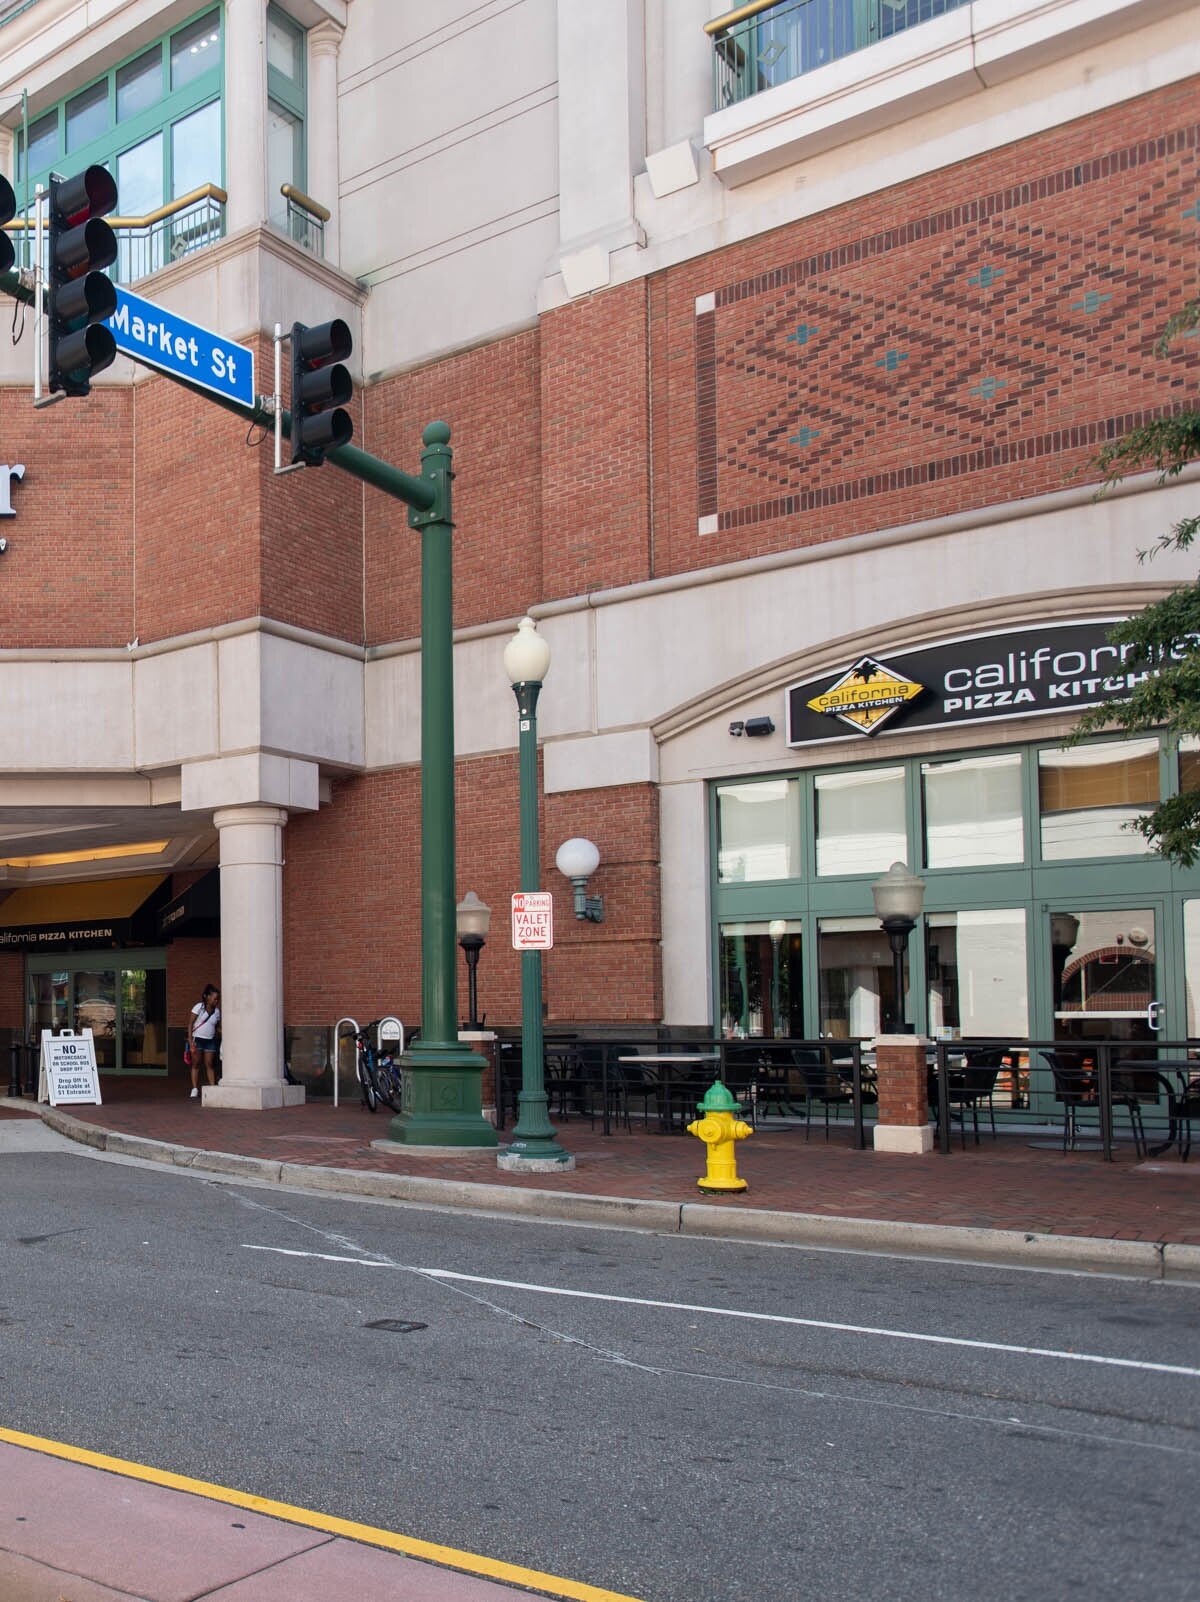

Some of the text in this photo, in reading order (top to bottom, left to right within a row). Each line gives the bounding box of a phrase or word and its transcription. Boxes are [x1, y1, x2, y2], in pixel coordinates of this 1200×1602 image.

[109, 304, 236, 384] Market St
[819, 684, 909, 706] california
[944, 689, 1036, 714] PIZZA
[825, 696, 903, 713] PIZZA KITCHEN
[516, 914, 549, 925] VALET
[39, 931, 66, 941] PIZZA
[69, 928, 112, 940] KITCHEN
[518, 926, 547, 938] ZONE
[62, 1045, 77, 1054] NO
